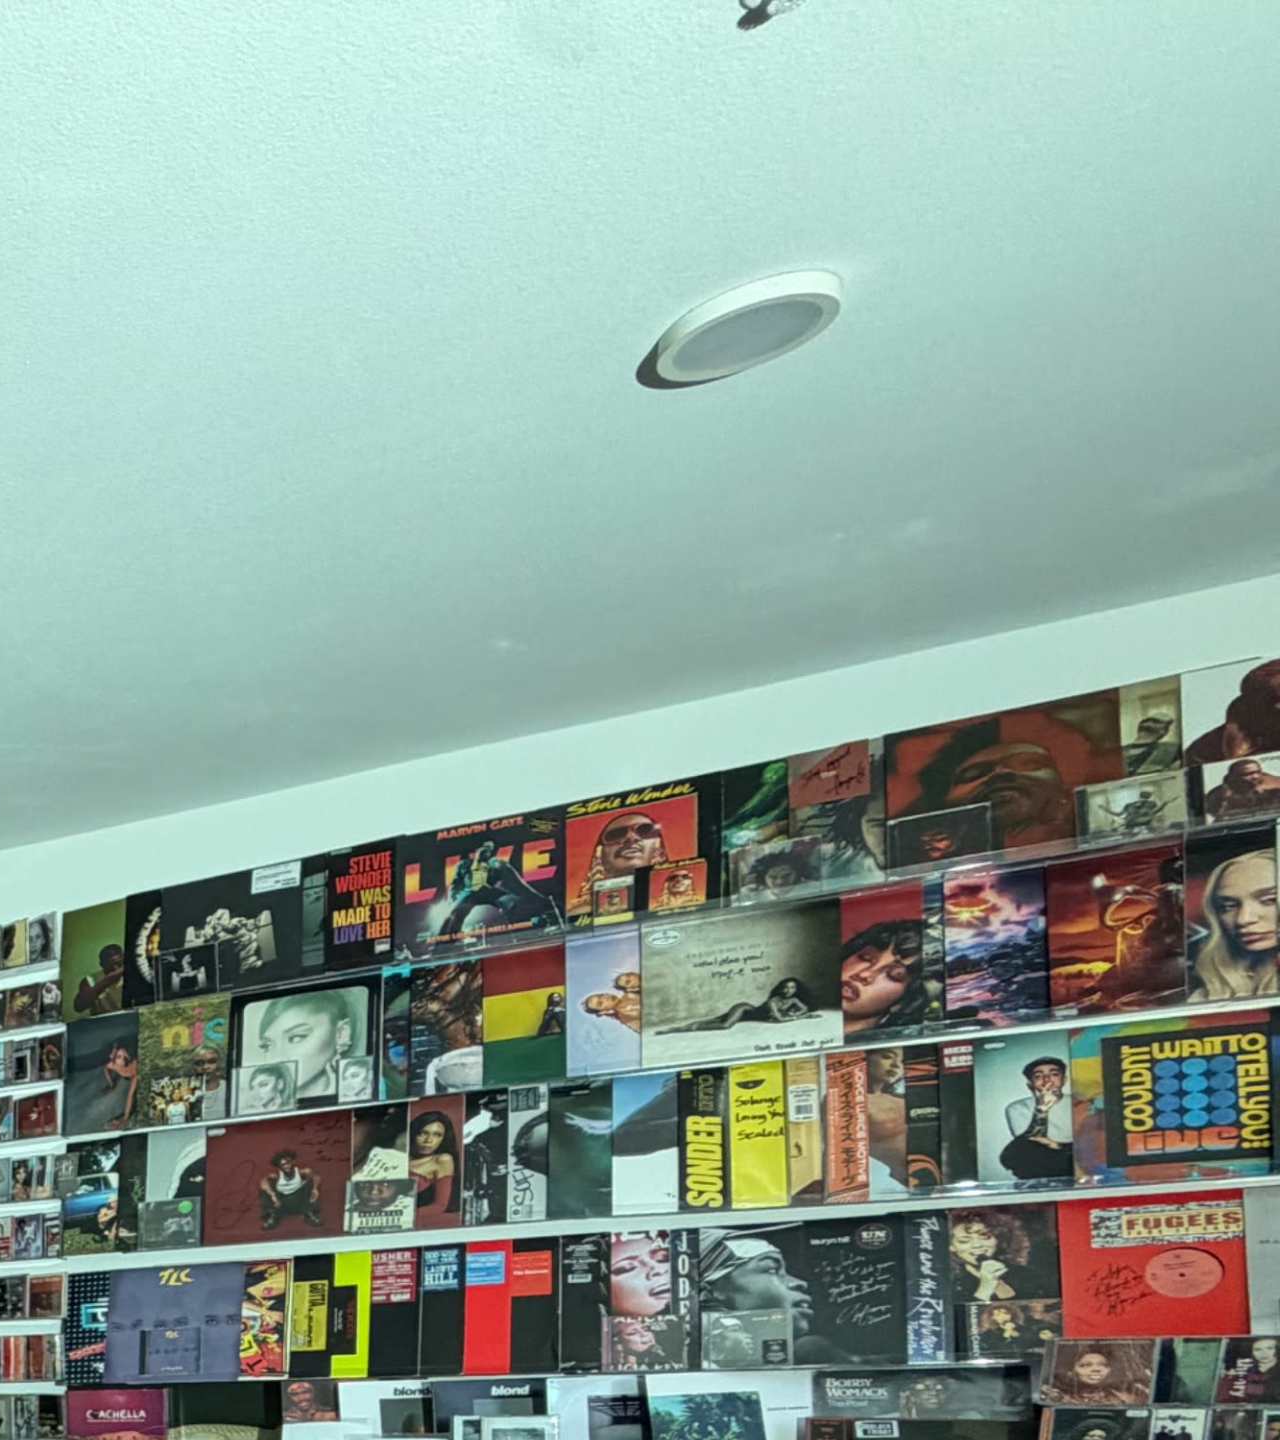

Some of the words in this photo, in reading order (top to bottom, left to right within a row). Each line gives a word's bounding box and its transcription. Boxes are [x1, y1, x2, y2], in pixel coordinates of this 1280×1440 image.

[349, 850, 393, 874] STEVIE
[335, 868, 392, 895] WONDER
[360, 885, 392, 907] WAS
[332, 905, 371, 929] MADE
[374, 902, 391, 920] TO
[334, 924, 364, 945] LOVE
[366, 919, 391, 940] HER
[685, 1115, 724, 1209] SONDER
[1125, 1210, 1243, 1231] FUGEES
[491, 1384, 531, 1397] blond
